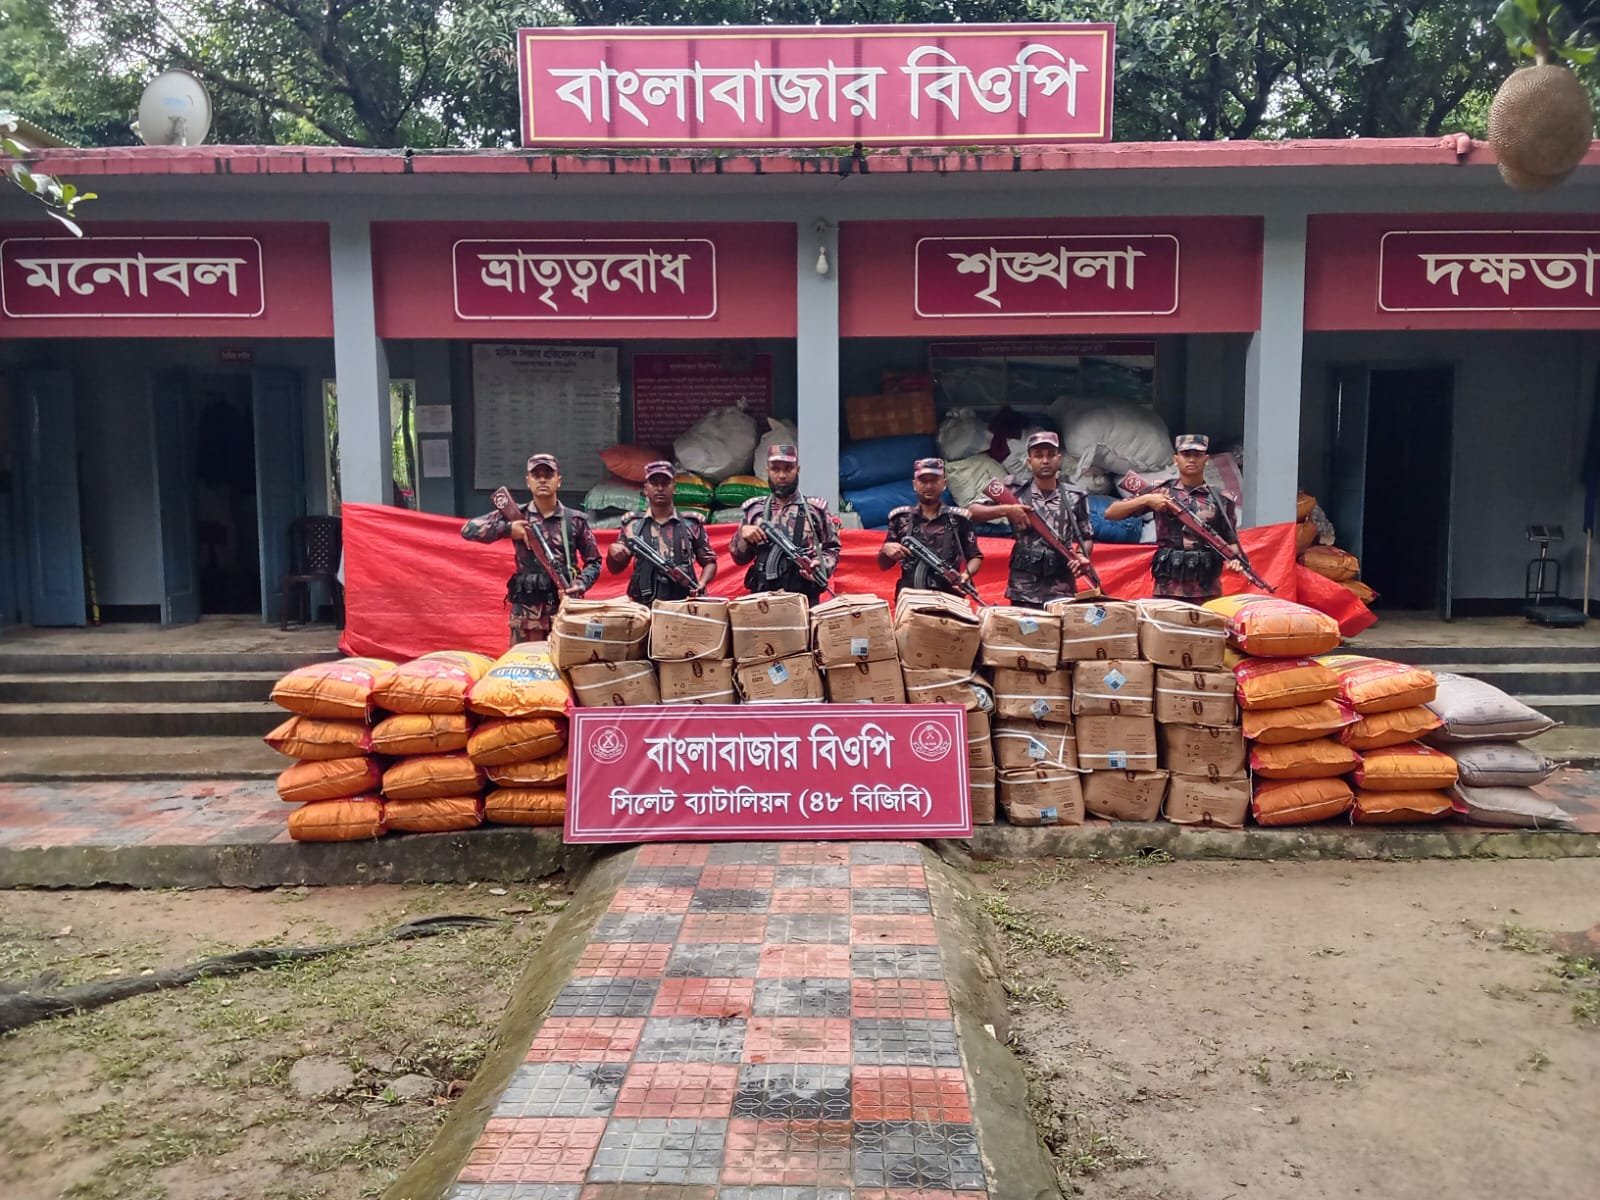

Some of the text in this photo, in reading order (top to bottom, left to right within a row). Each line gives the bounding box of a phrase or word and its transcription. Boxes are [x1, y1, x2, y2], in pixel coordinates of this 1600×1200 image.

[547, 44, 1088, 126] বাংলাবাজার বিওপি
[15, 251, 247, 297] মনোবল
[477, 248, 691, 312] ভ্রাতৃত্ববোধ
[947, 245, 1147, 309] শৃঙ্খলা
[1417, 247, 1600, 297] দক্ষতা
[643, 732, 801, 774] বাংলাবাজার
[807, 722, 895, 770] বিওপি
[608, 783, 933, 819] সিলেট ব্যাটালিয়ন (৪৮ বিজিবি)
